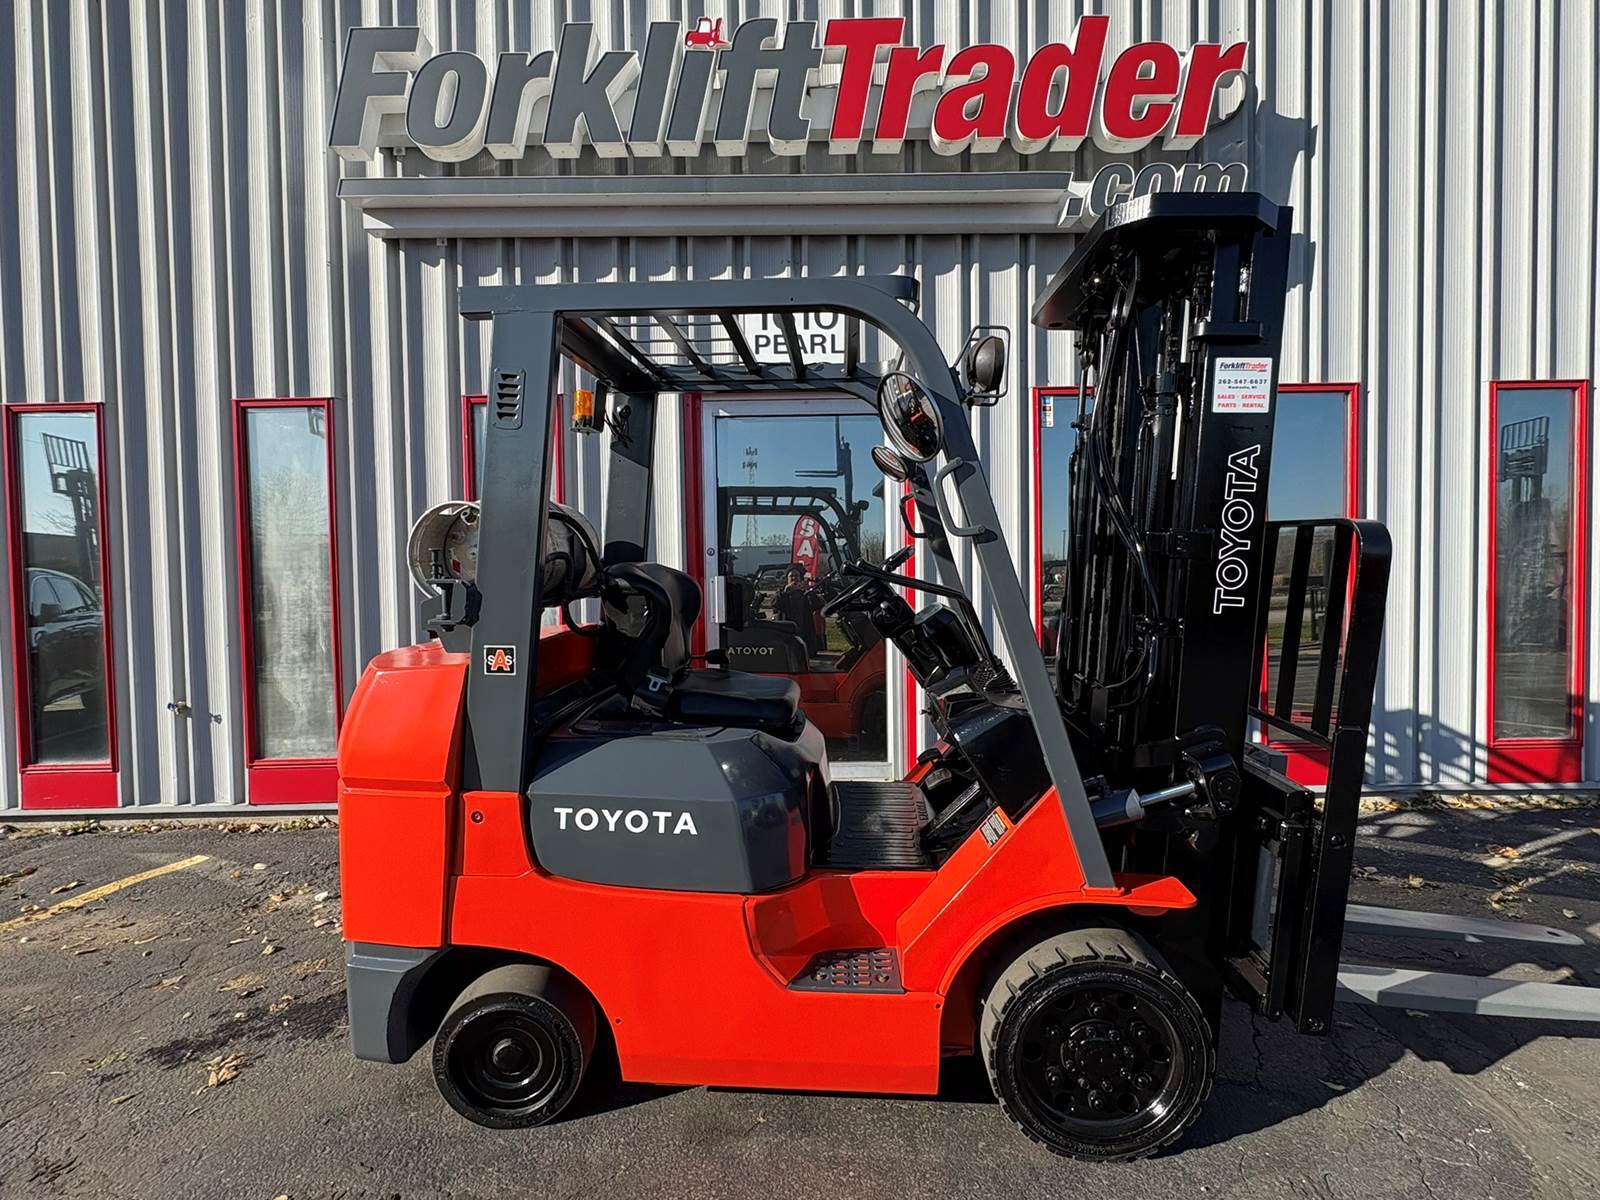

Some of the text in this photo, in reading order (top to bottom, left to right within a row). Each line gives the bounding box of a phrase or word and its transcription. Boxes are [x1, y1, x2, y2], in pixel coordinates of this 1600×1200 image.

[329, 15, 1248, 153] ForkliftTrader
[1060, 162, 1248, 217] .com
[1213, 444, 1261, 614] TOYOTA
[553, 807, 698, 835] TOYOTA
